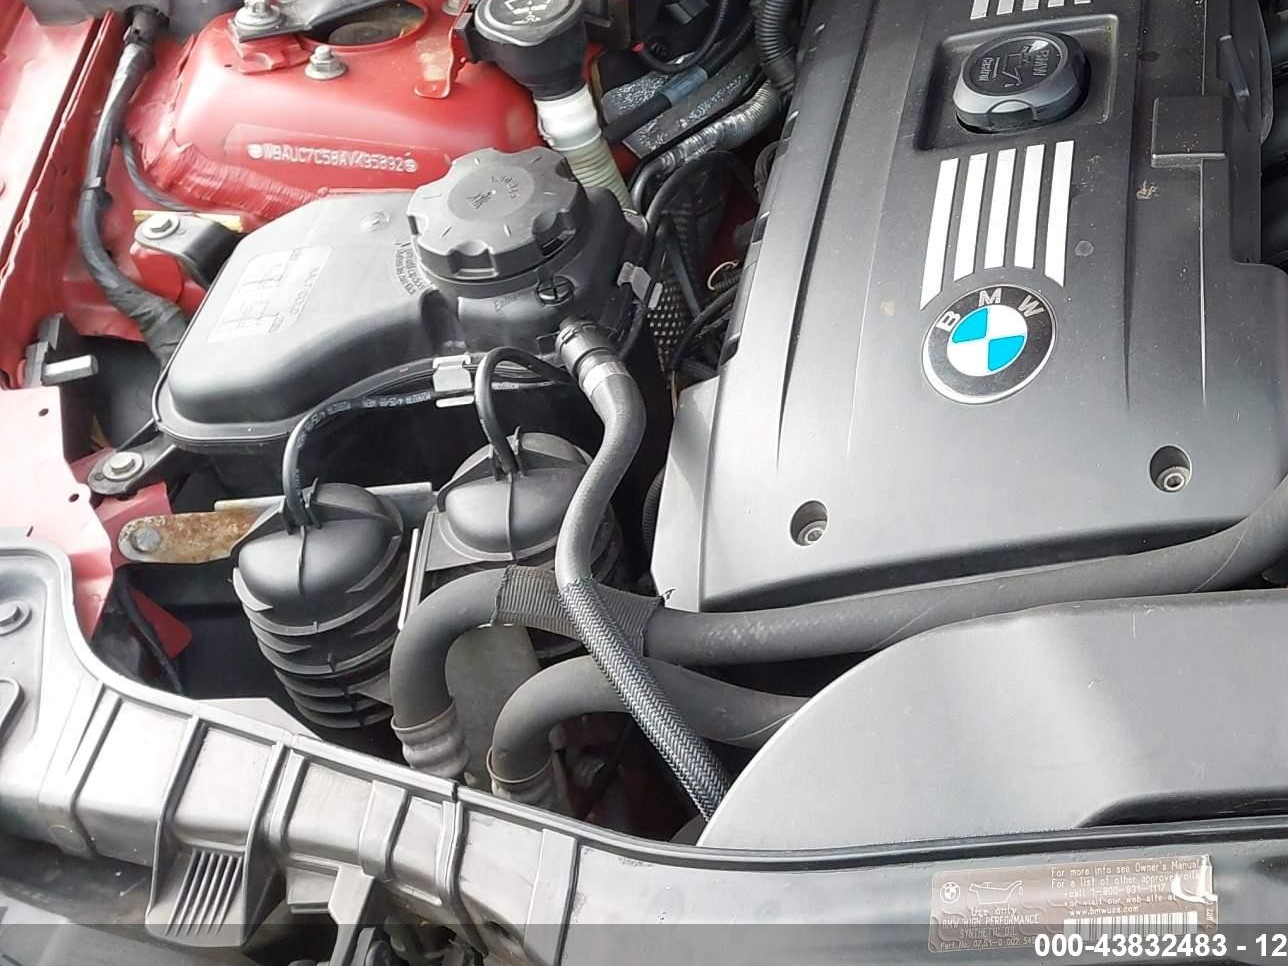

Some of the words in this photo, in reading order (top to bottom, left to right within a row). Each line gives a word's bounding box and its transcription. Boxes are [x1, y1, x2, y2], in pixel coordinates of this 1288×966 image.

[936, 288, 1045, 332] BMW
[1051, 867, 1064, 877] For
[1135, 861, 1166, 873] Owner's
[1051, 879, 1064, 889] For
[1080, 876, 1095, 887] list
[1115, 875, 1136, 885] other
[971, 906, 987, 916] Use
[995, 905, 1017, 915] only
[985, 914, 1039, 924] PERFORMANCE
[960, 928, 1001, 939] SYNTHETIC
